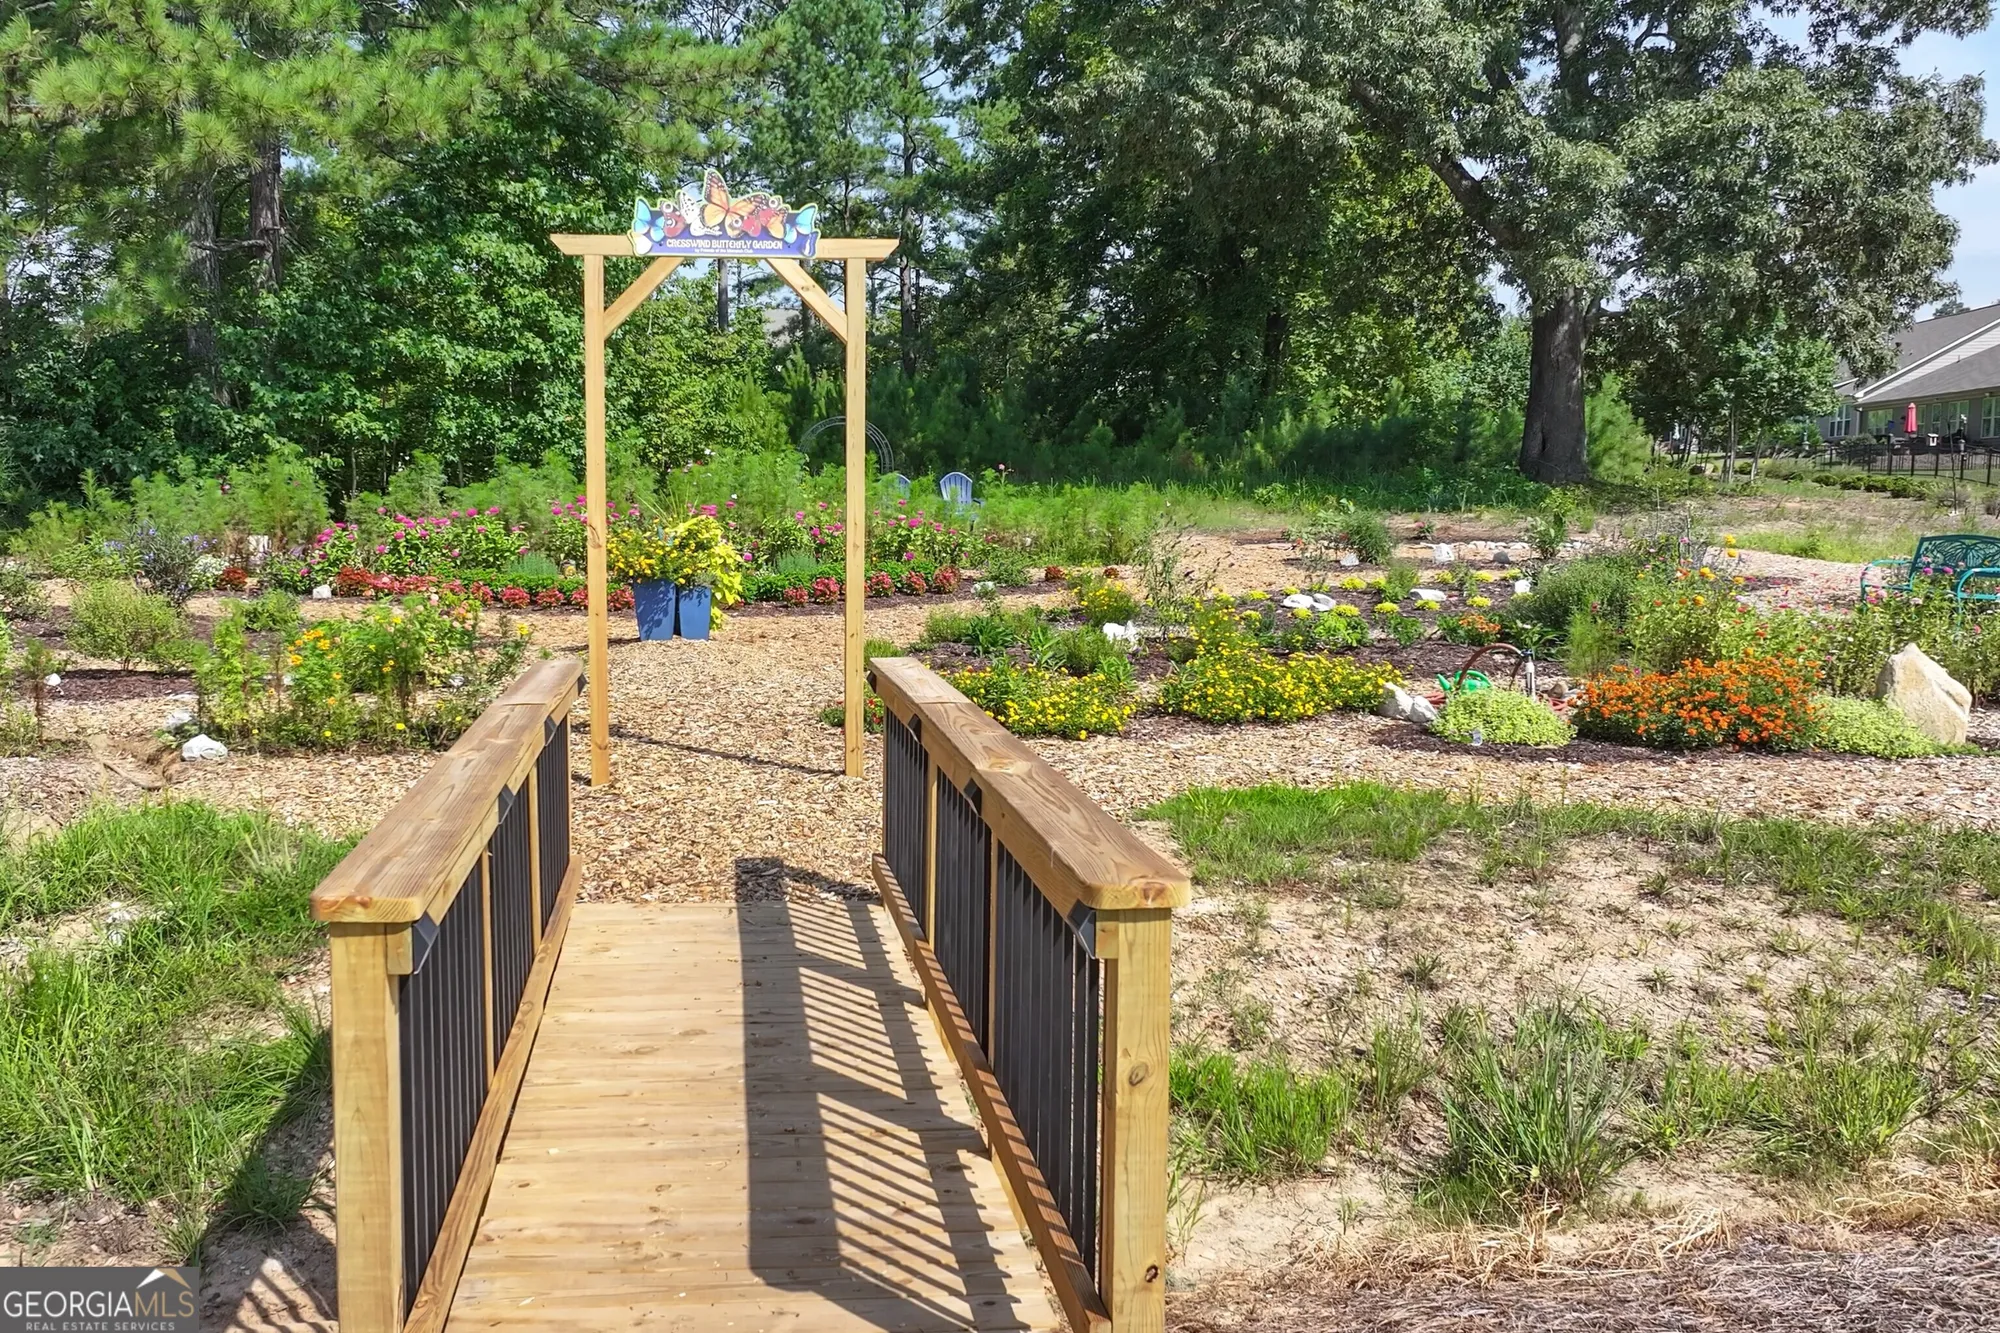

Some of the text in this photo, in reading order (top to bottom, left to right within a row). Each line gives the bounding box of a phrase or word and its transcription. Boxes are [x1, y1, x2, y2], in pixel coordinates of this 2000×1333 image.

[666, 239, 783, 249] CRESSWIND BUTTERFLY GARDEN
